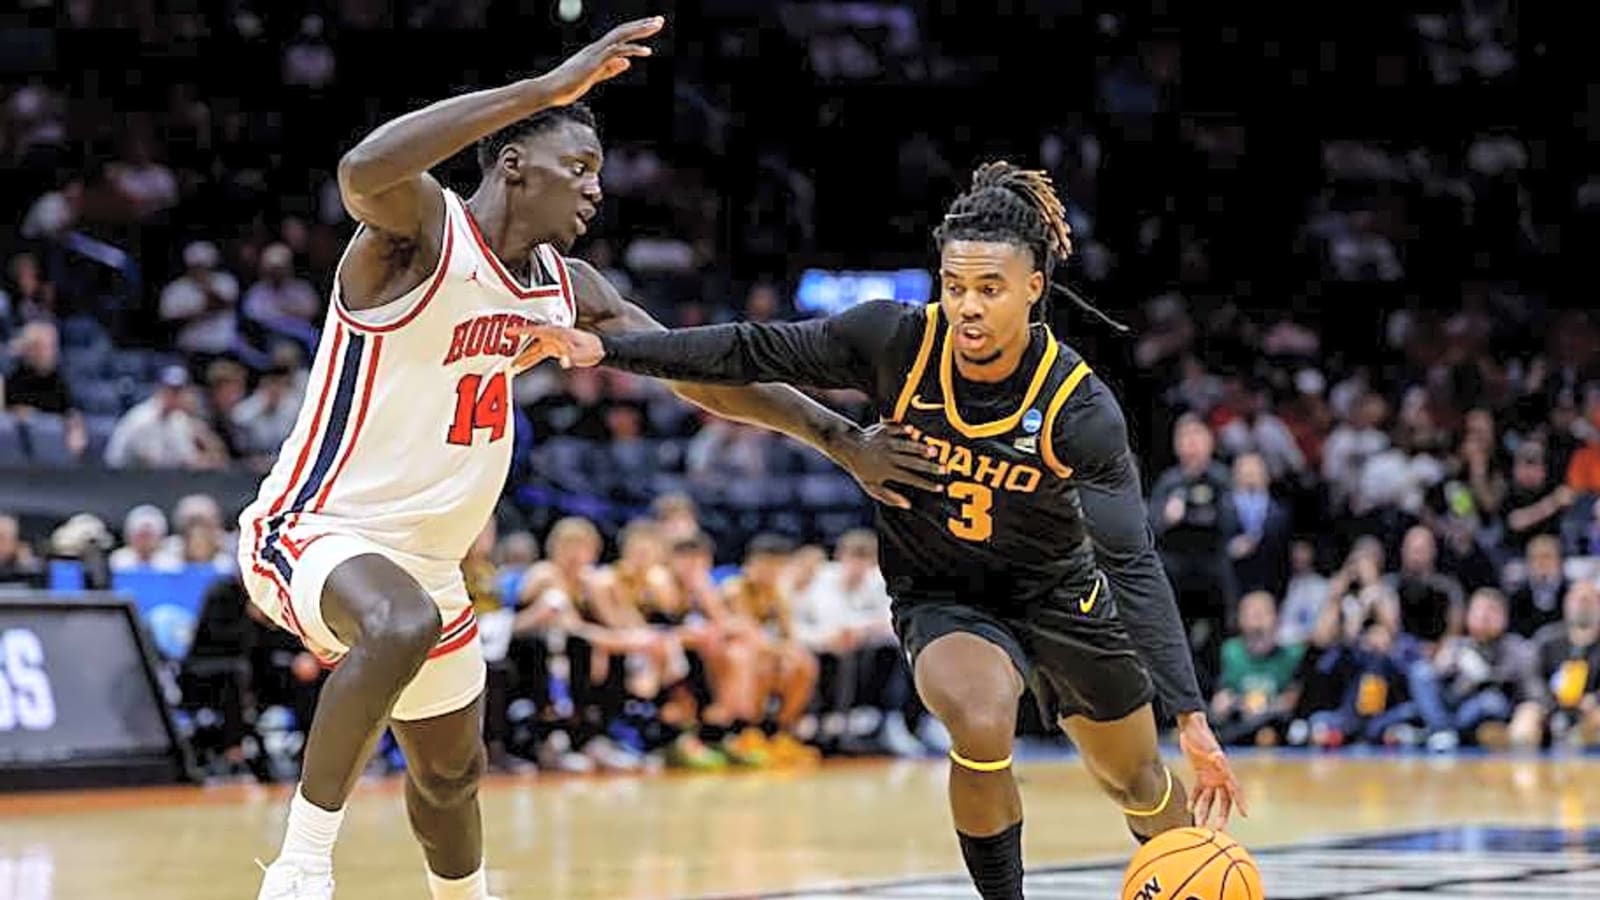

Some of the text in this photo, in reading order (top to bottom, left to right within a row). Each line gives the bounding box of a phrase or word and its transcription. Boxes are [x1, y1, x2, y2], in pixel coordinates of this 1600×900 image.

[443, 313, 540, 366] HOUS
[446, 372, 509, 446] 14
[910, 428, 1042, 493] DAHO
[947, 480, 993, 541] 3
